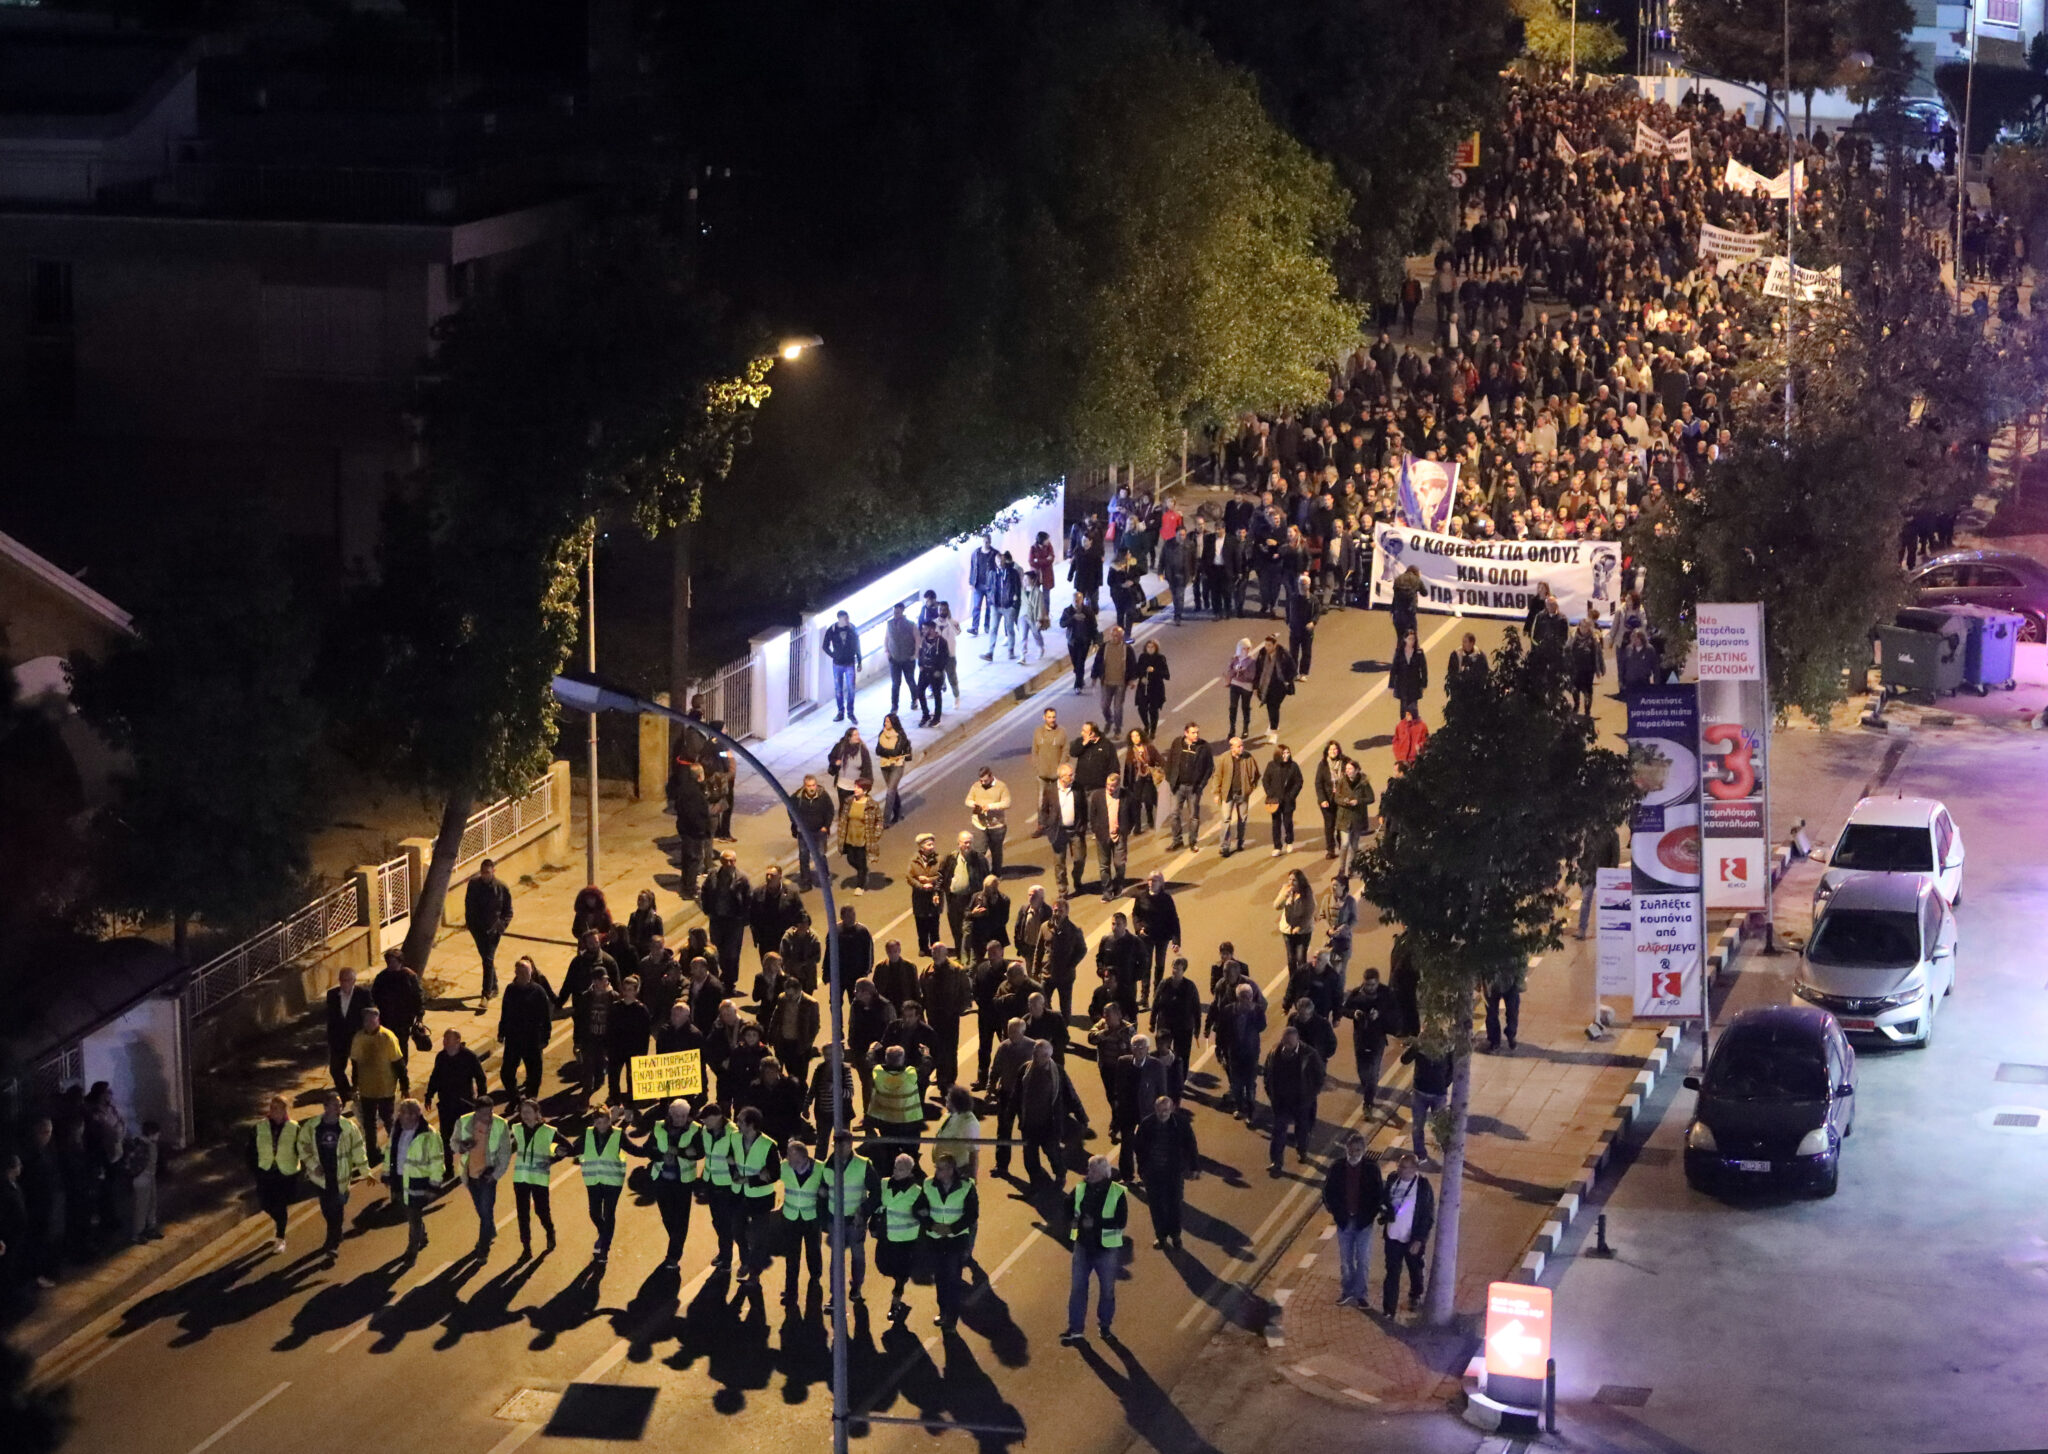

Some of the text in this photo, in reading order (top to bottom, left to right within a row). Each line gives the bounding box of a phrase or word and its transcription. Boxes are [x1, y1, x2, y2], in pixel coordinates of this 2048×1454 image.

[1410, 535, 1580, 563] Ο ΚΑΘΕΝΑΣ ΓΙΑ ΟΛΟΥΣ
[1457, 565, 1528, 586] ΚΑΙ ΟΛΟΙ
[1430, 585, 1453, 604] ΓΙΑ
[1456, 589, 1489, 607] ΤΟΝ
[1700, 652, 1748, 662] HEATING
[1700, 664, 1755, 675] EKONOMY
[1704, 807, 1756, 819] χαμηλότερη
[1704, 817, 1760, 828] κατανάλωση
[1640, 899, 1692, 911] Συλλέξτε
[1640, 914, 1692, 924] κουπόνια
[1656, 927, 1677, 937] από
